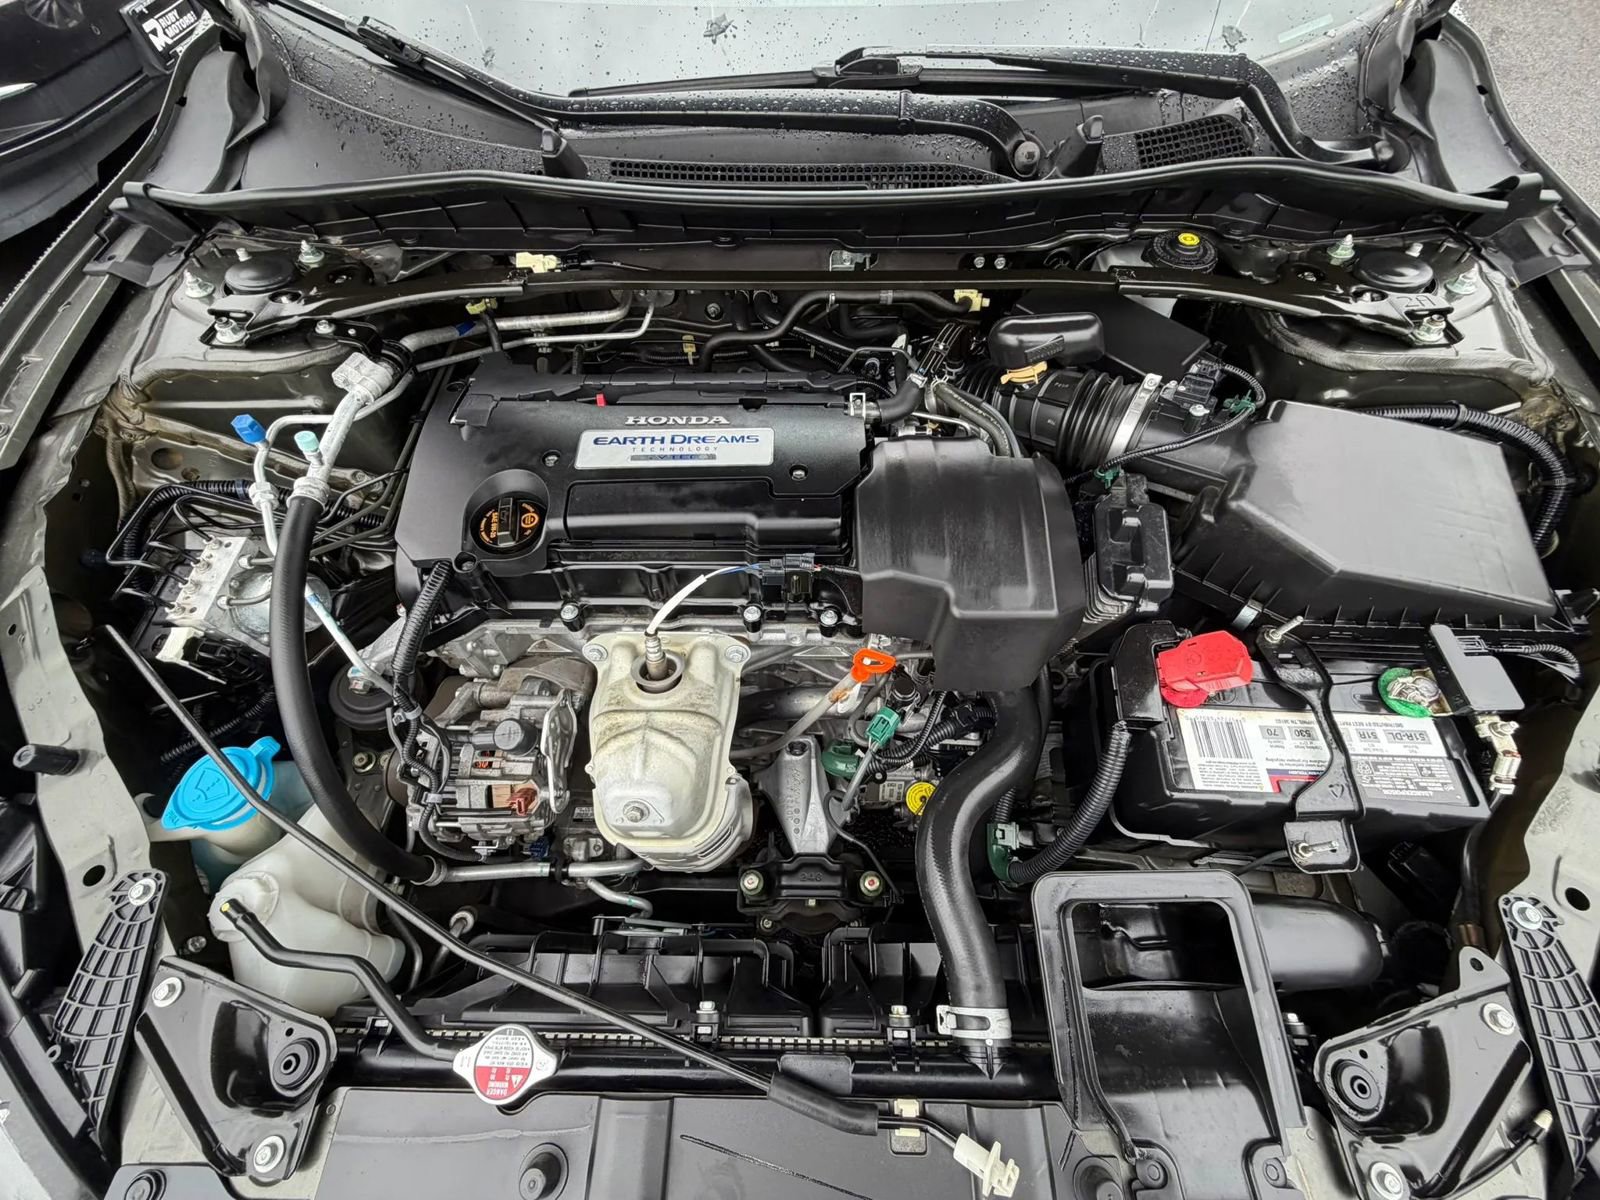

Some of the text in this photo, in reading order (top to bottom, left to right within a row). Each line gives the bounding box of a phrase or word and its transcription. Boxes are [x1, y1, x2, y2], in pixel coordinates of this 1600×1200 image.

[158, 9, 180, 29] RUBY
[624, 415, 730, 426] HONDA
[593, 434, 760, 446] EARTH DREAMS
[1266, 728, 1278, 737] 70
[1294, 729, 1311, 738] 530
[1358, 731, 1378, 740] 51R
[486, 1088, 508, 1096] DANGER
